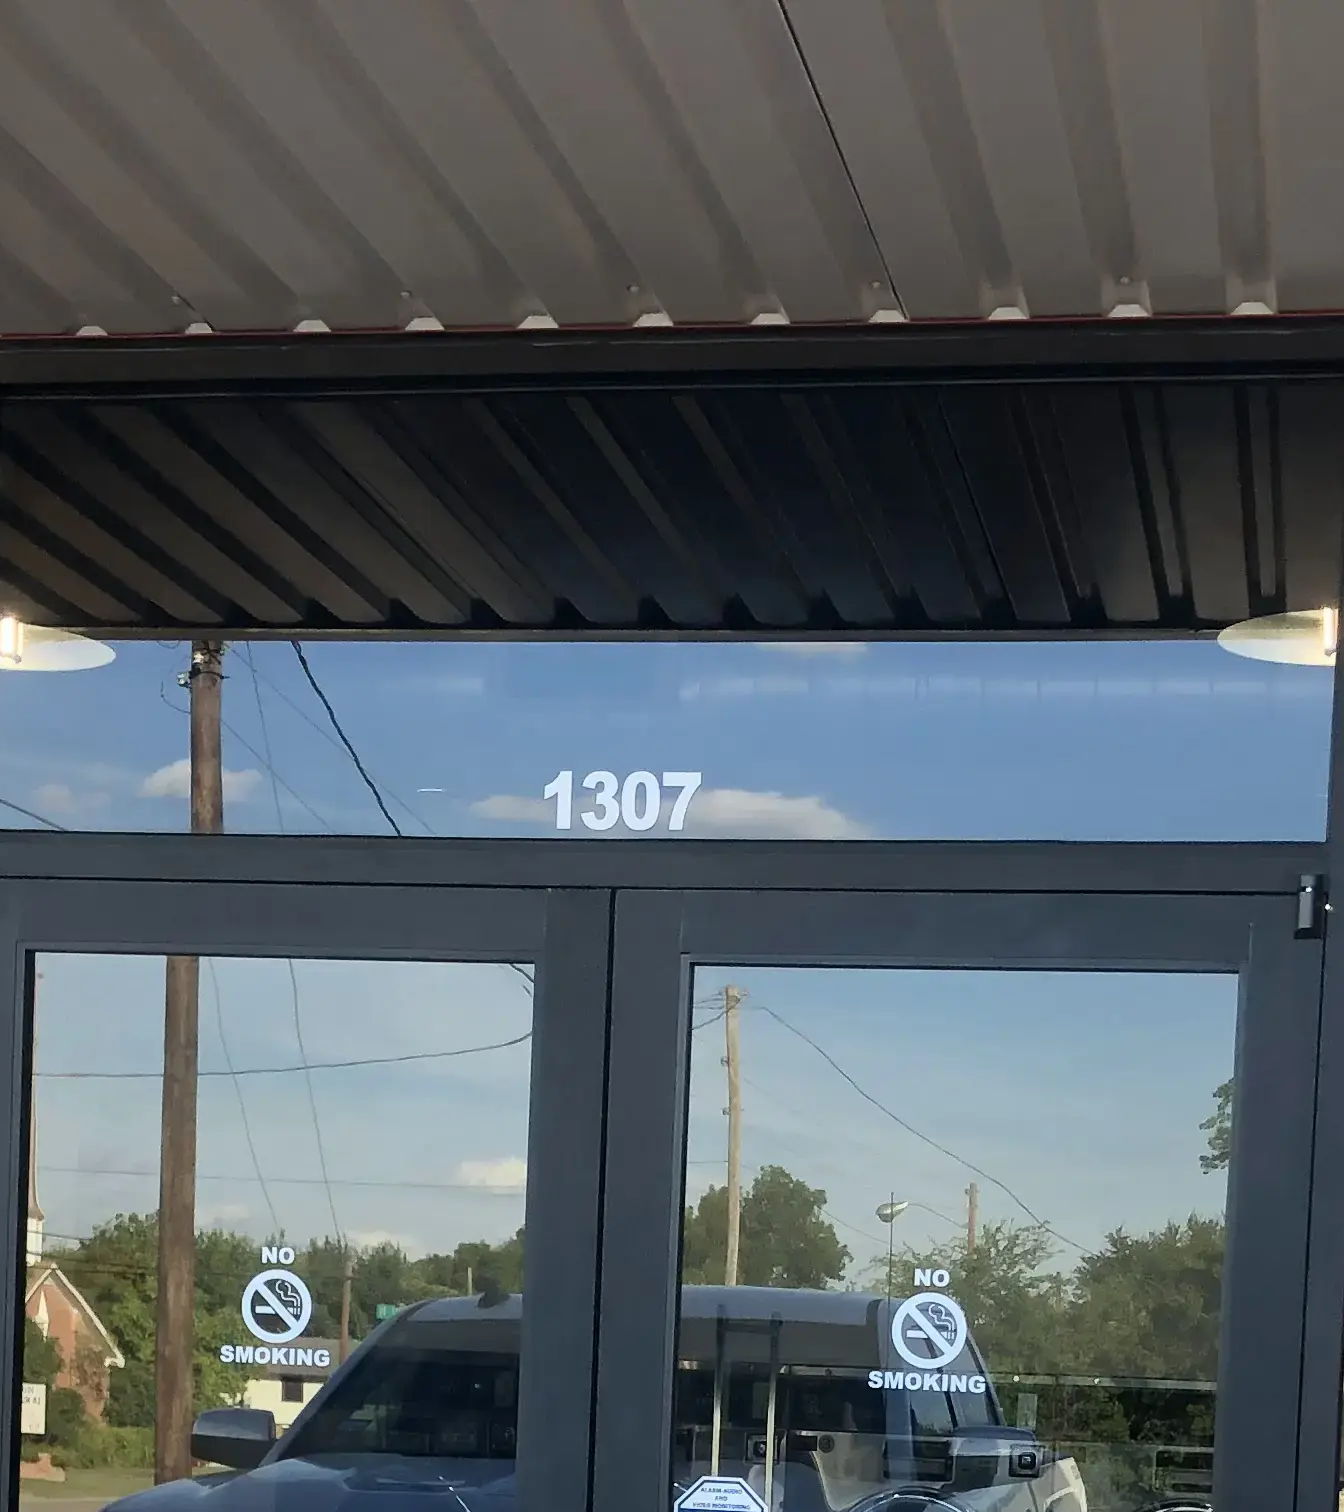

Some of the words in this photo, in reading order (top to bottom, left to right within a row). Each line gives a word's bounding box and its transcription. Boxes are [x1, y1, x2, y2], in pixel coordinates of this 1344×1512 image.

[543, 770, 703, 831] 1307
[261, 1246, 295, 1265] NO
[914, 1268, 950, 1287] NO
[219, 1345, 331, 1367] SMOKING
[867, 1370, 986, 1394] SMOKING
